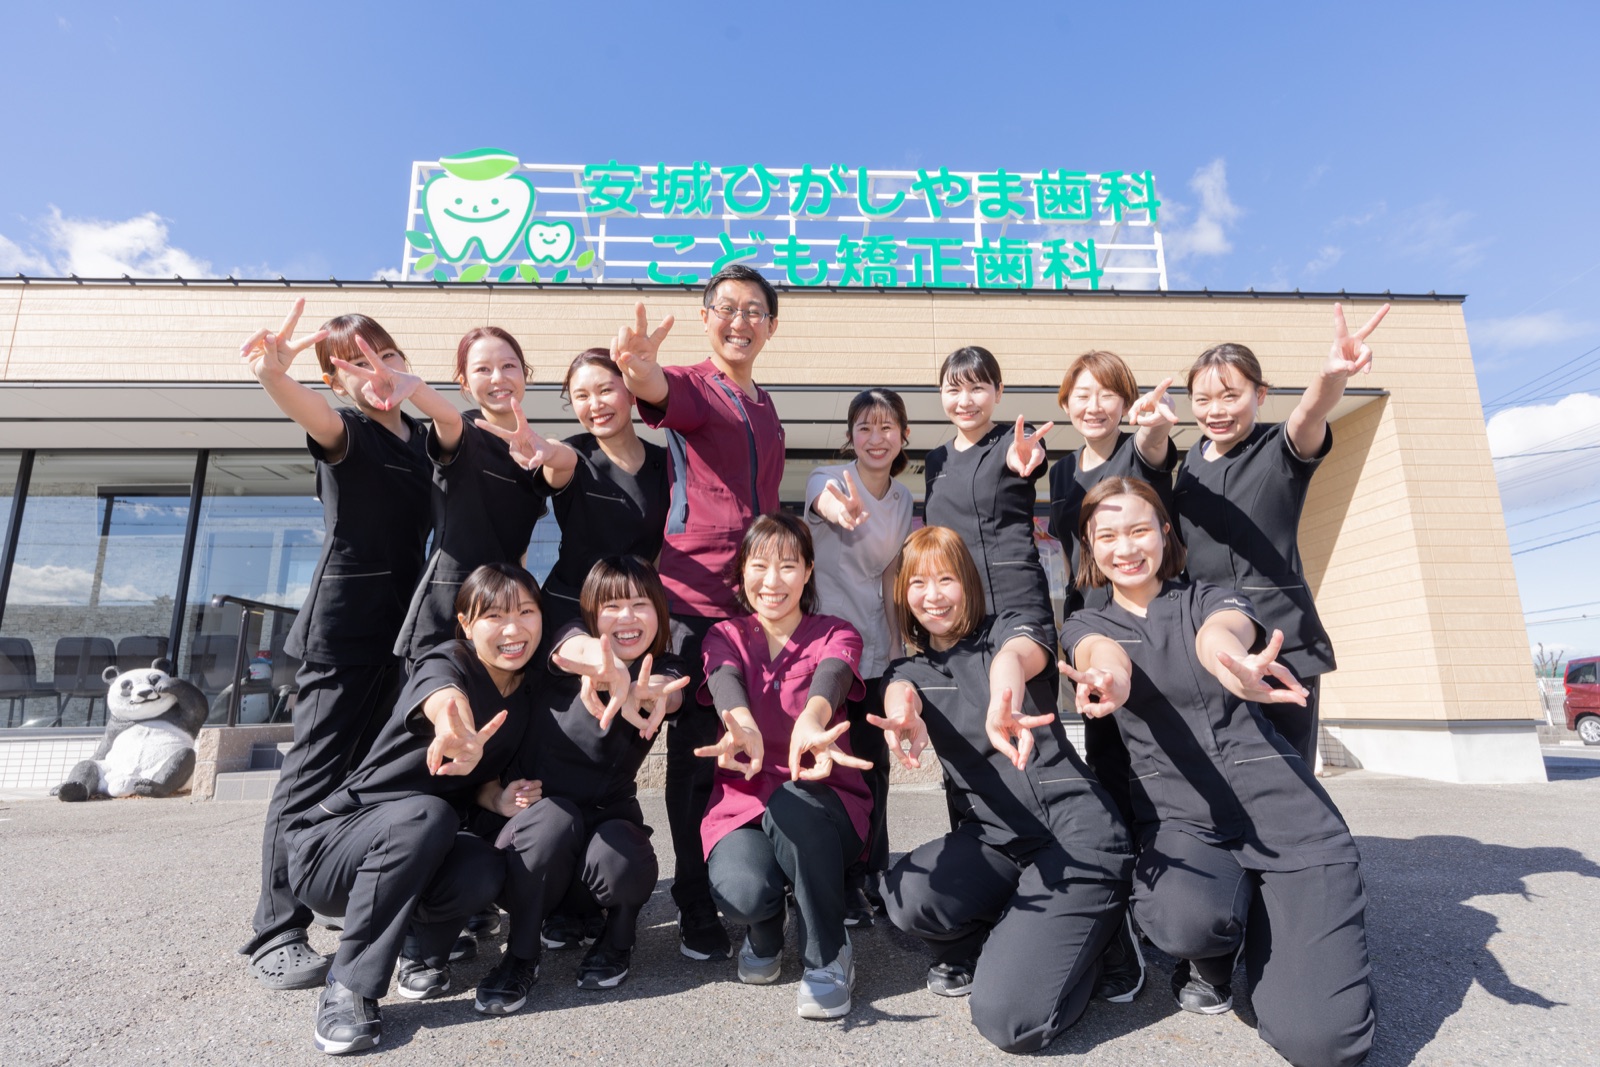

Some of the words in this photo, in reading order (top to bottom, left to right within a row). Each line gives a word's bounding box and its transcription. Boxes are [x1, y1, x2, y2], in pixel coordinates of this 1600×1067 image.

[582, 160, 1162, 224] 安城ひがしやま歯科
[648, 230, 1104, 290] こども矯正歯科
